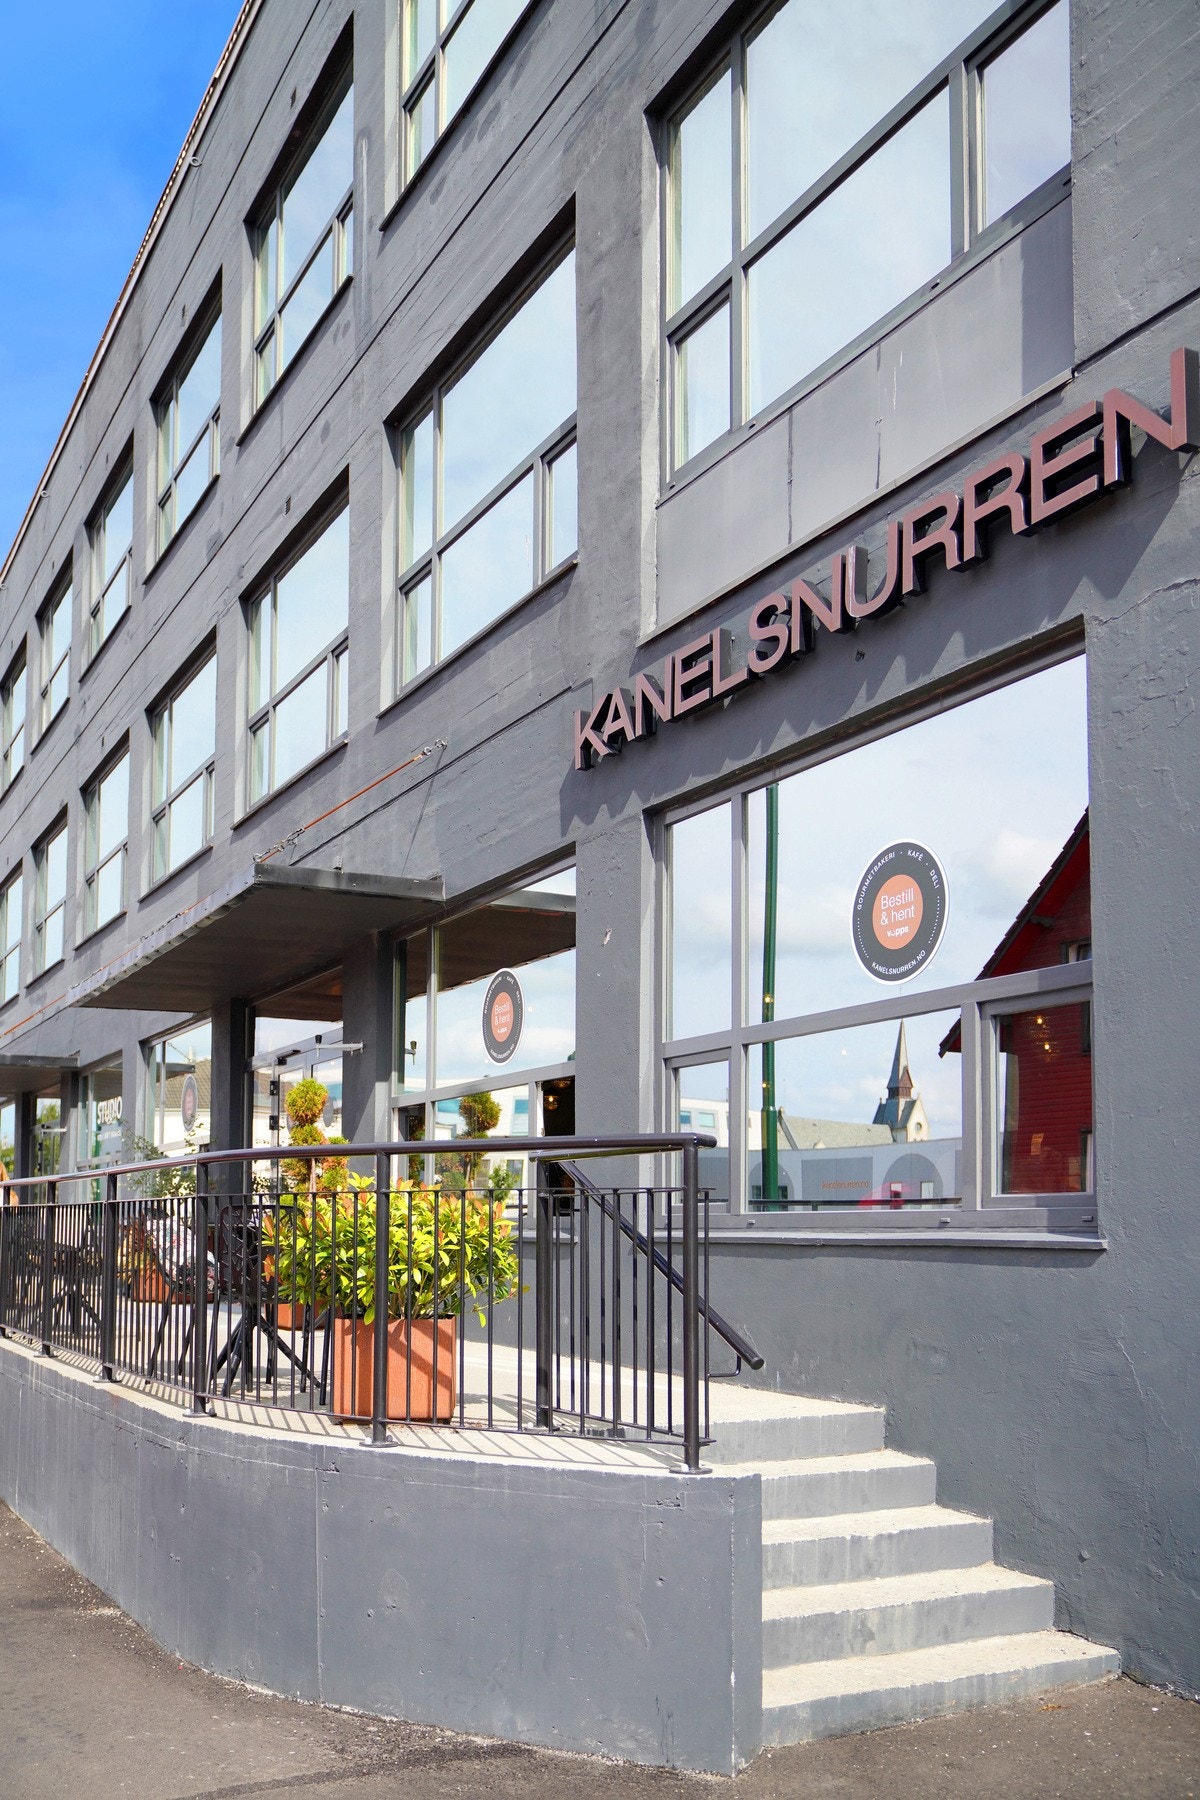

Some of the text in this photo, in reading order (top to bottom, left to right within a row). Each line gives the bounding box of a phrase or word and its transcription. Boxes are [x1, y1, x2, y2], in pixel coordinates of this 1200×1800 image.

[574, 347, 1191, 770] KANELSNURREN
[857, 851, 896, 910] GOURMETBAKERI
[929, 869, 940, 889] DELI
[880, 888, 914, 909] Bestill
[880, 905, 915, 926] & hent
[871, 949, 926, 975] KANELSNURREN.NO
[97, 1096, 122, 1124] STUDIO
